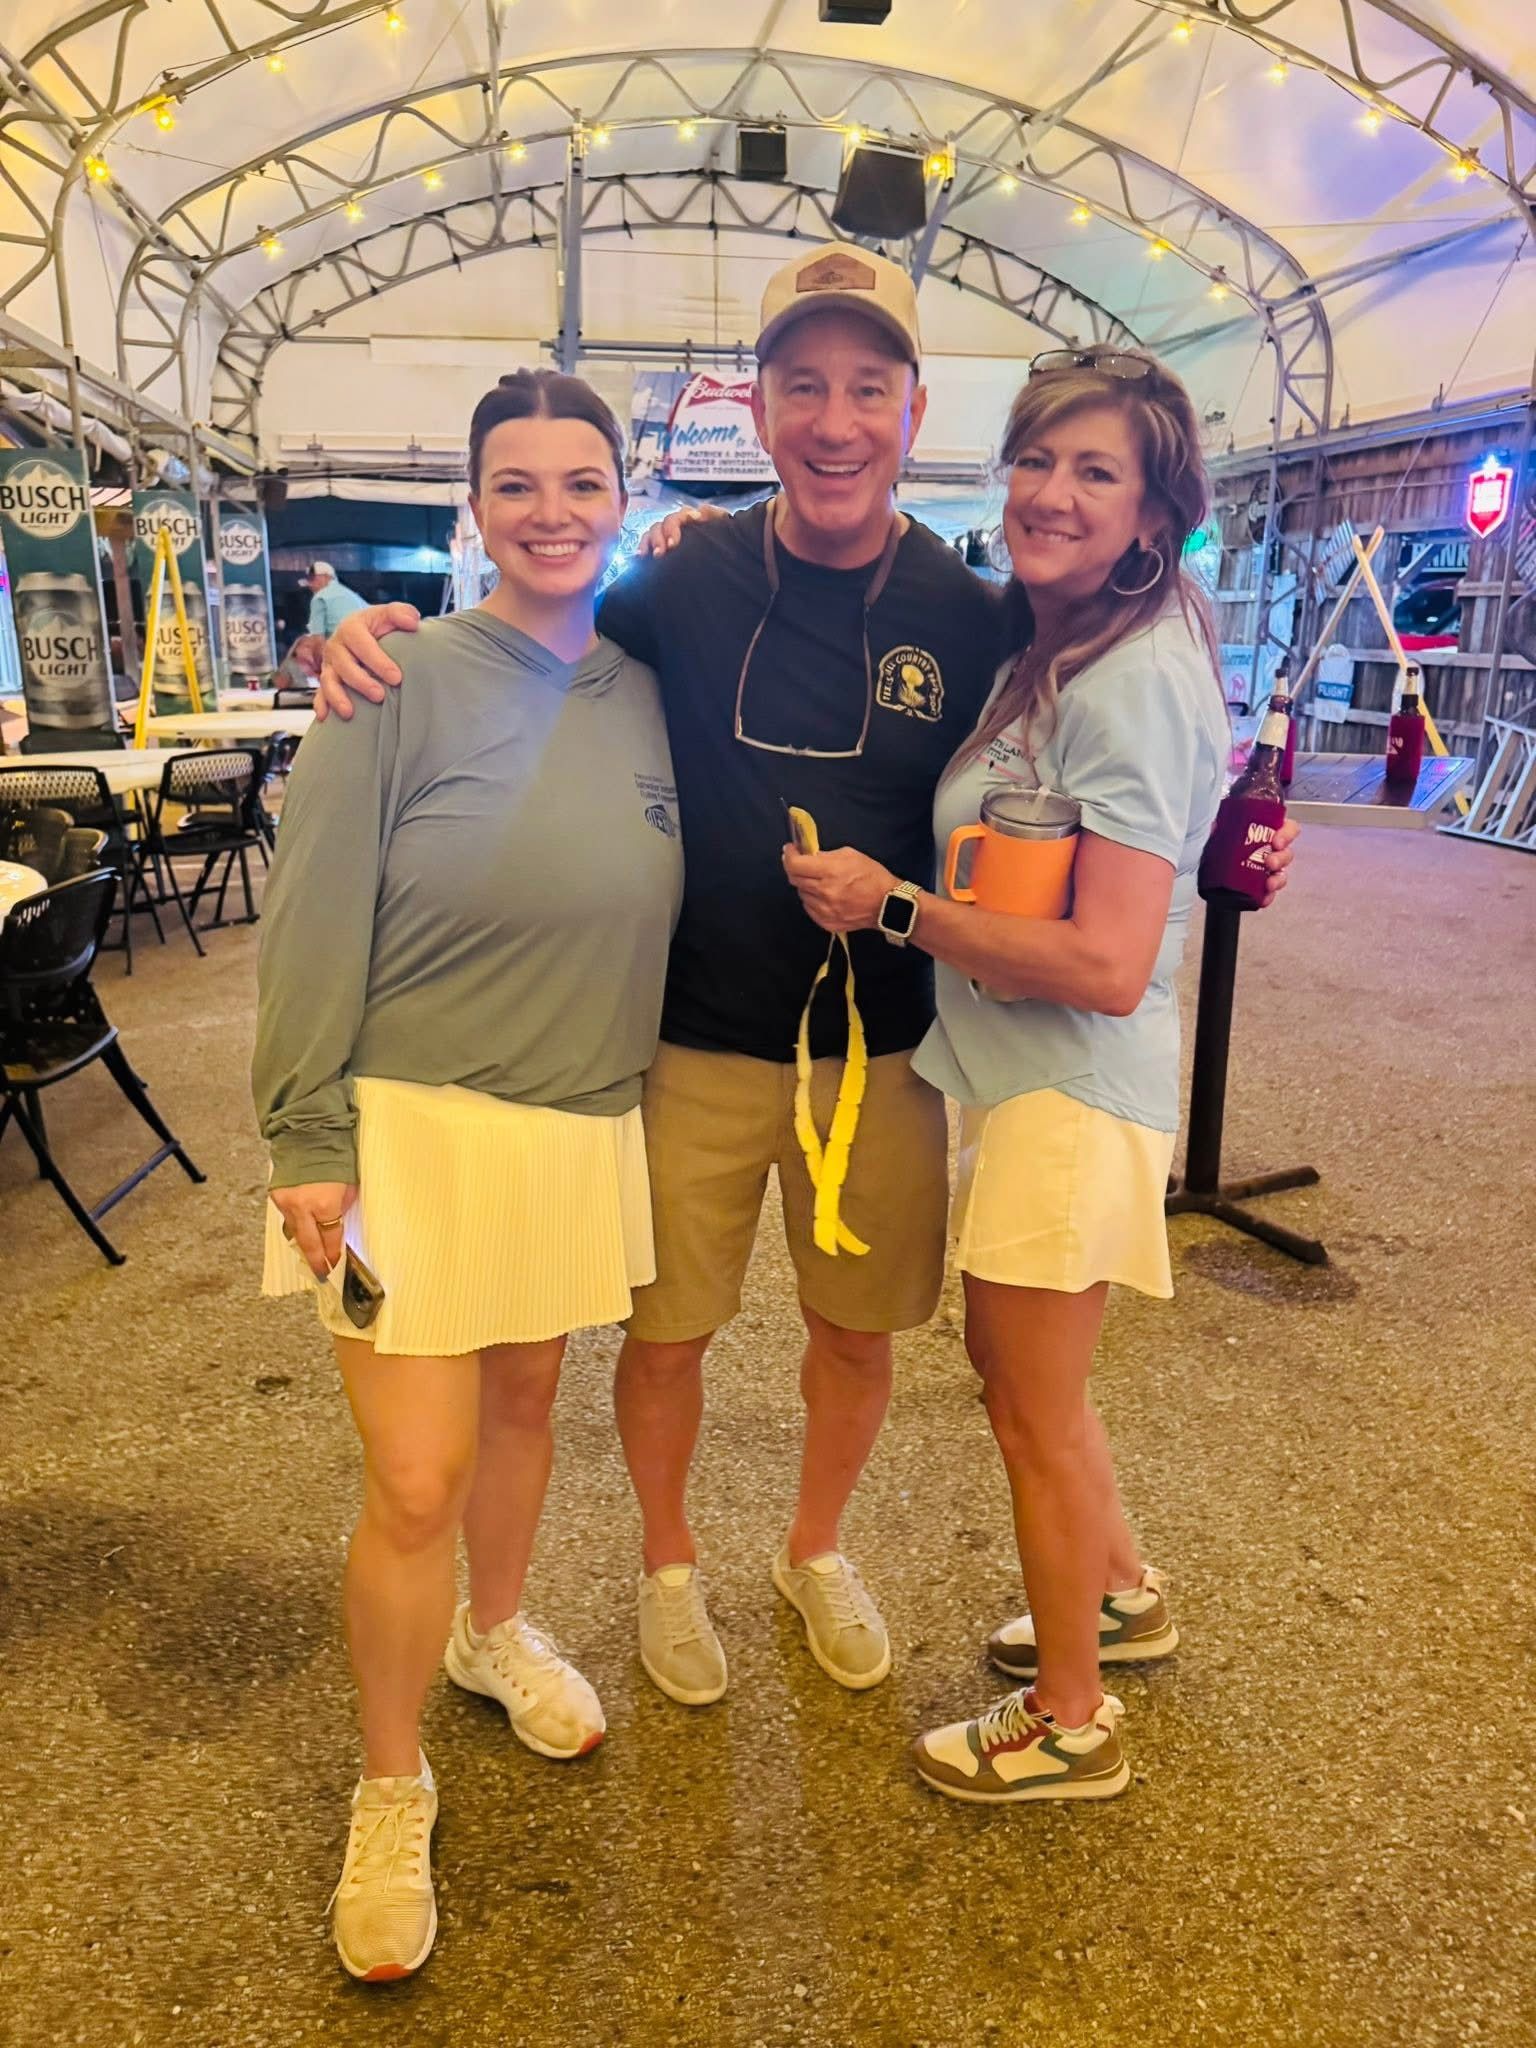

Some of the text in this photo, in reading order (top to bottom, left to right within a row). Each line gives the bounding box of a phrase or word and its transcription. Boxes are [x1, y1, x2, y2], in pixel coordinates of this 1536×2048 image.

[645, 421, 740, 451] Welcome
[0, 485, 86, 511] BUSCH
[20, 512, 71, 524] LIGHT
[136, 518, 198, 537] BUSCH
[23, 636, 97, 662] BUSCH
[162, 647, 197, 657] LIGT
[39, 663, 88, 676] LIGHT
